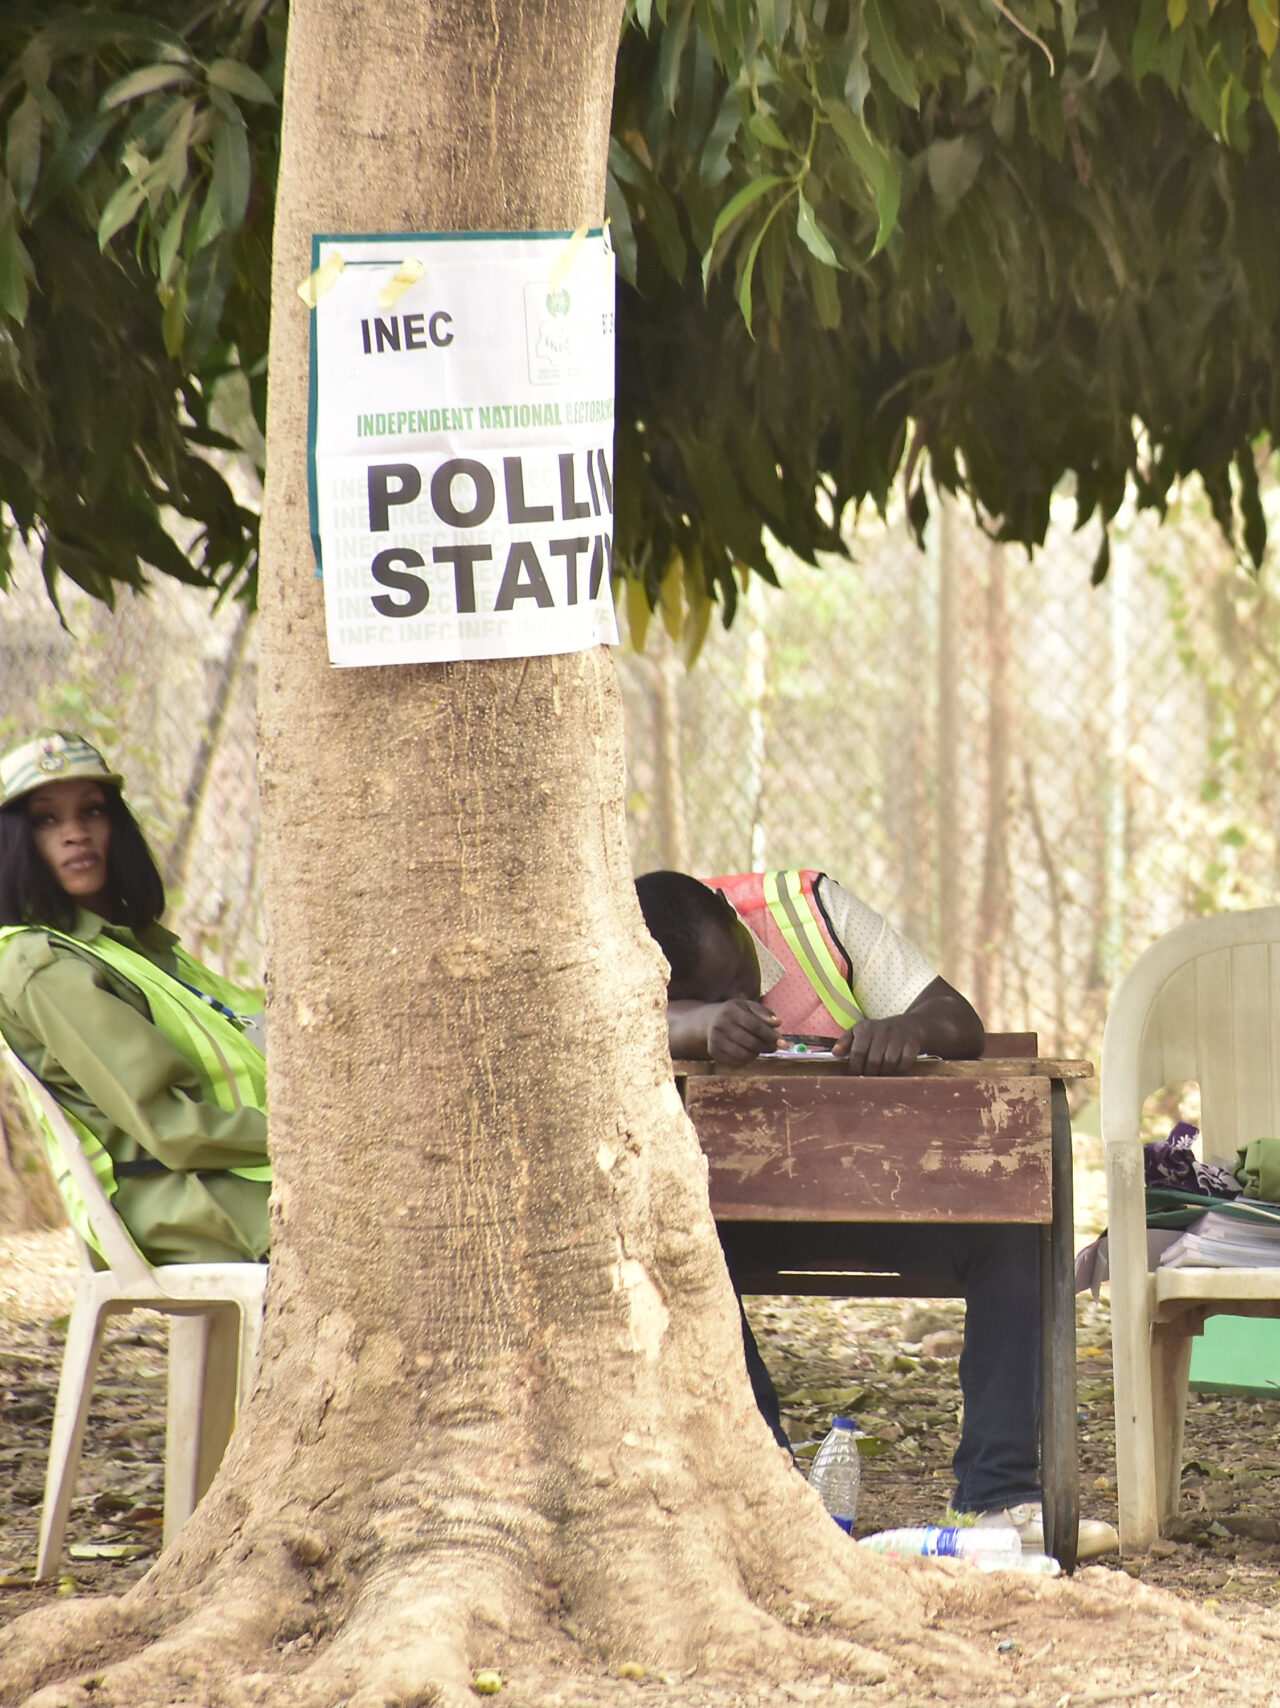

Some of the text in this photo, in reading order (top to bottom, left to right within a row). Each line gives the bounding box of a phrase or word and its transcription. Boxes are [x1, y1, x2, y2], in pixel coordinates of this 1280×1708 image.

[361, 311, 454, 354] INEC
[357, 407, 473, 437] INDEPENDENT
[479, 402, 562, 429] NATIONAL
[371, 533, 612, 618] STATI
